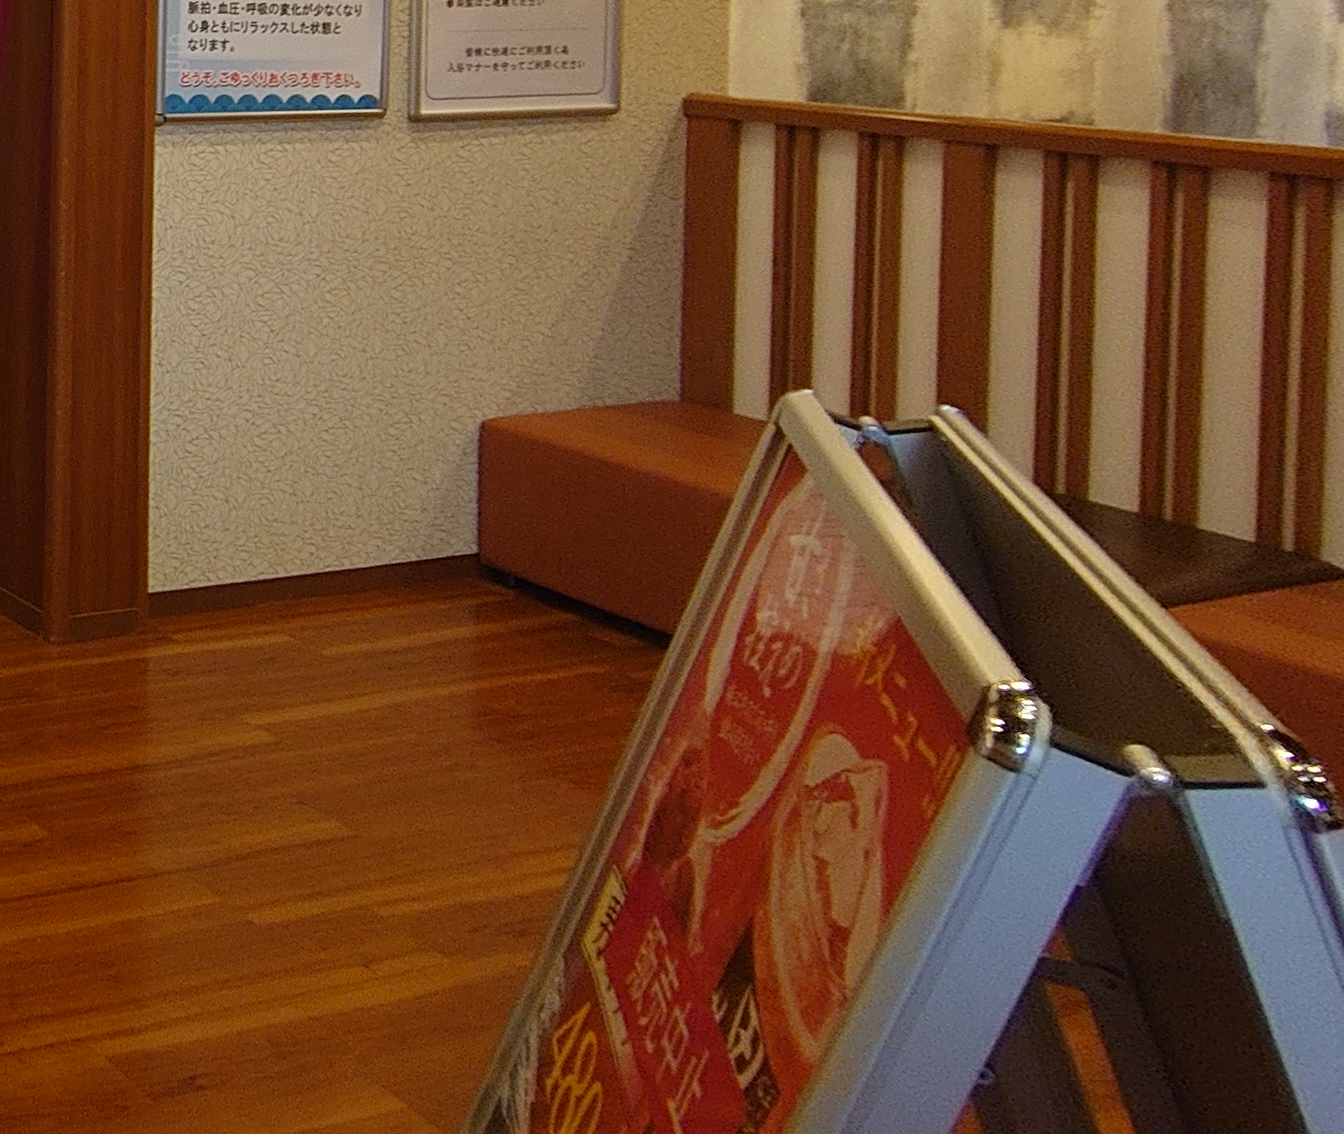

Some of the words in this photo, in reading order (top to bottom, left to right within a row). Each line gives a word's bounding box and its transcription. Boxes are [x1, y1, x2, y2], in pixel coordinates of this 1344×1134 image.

[188, 19, 342, 36] 心身ともにリラックスした状態と
[187, 38, 236, 53] なります。
